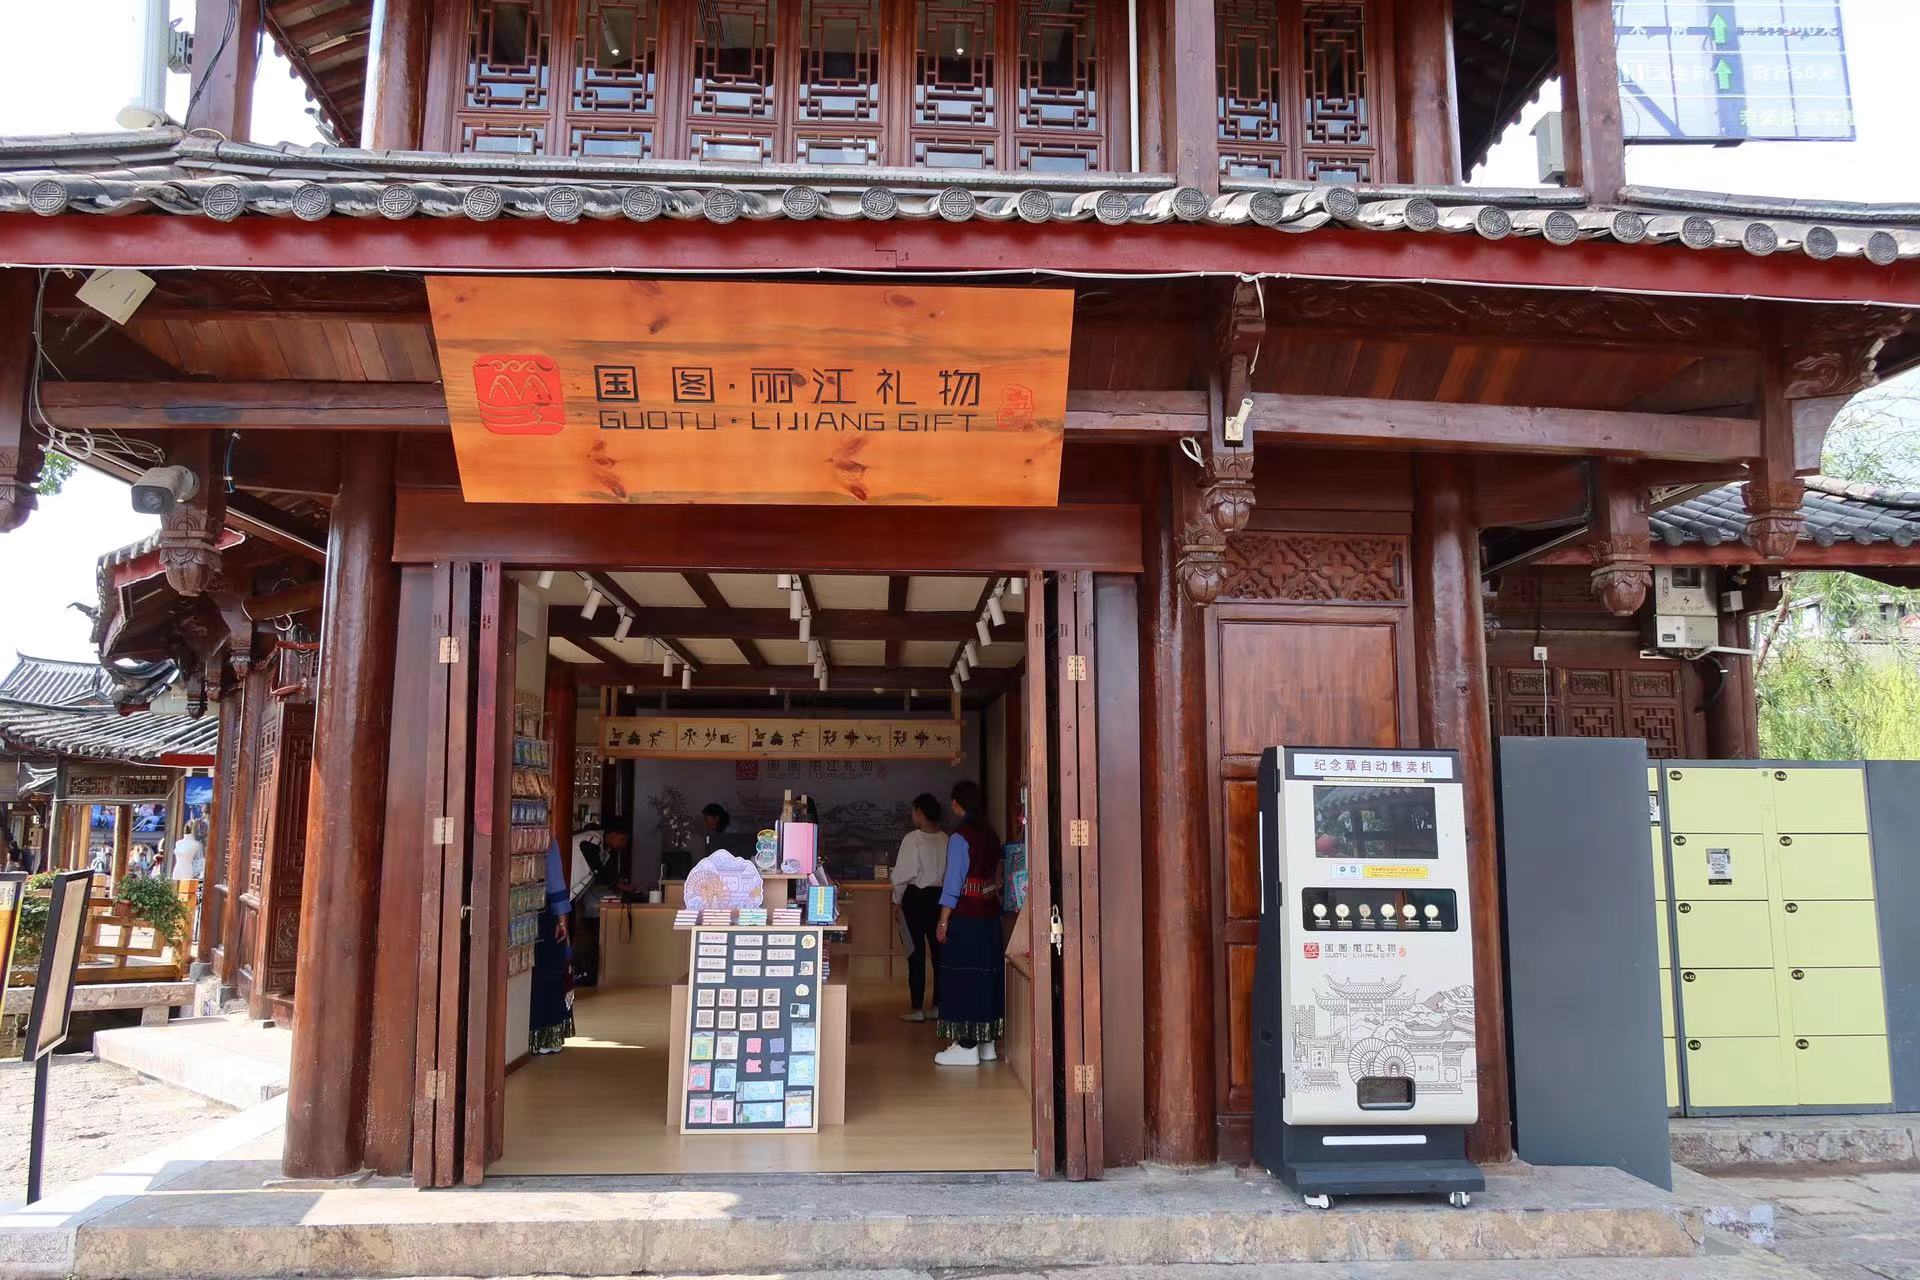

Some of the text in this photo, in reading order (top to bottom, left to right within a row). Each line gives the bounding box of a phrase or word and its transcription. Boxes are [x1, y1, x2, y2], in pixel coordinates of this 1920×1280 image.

[594, 365, 981, 405] 国图·丽江礼物
[599, 410, 717, 431] GUOTU
[751, 411, 886, 433] LIJIANG
[898, 413, 979, 433] GIFT
[1314, 758, 1434, 774] 纪念章自动售卖机
